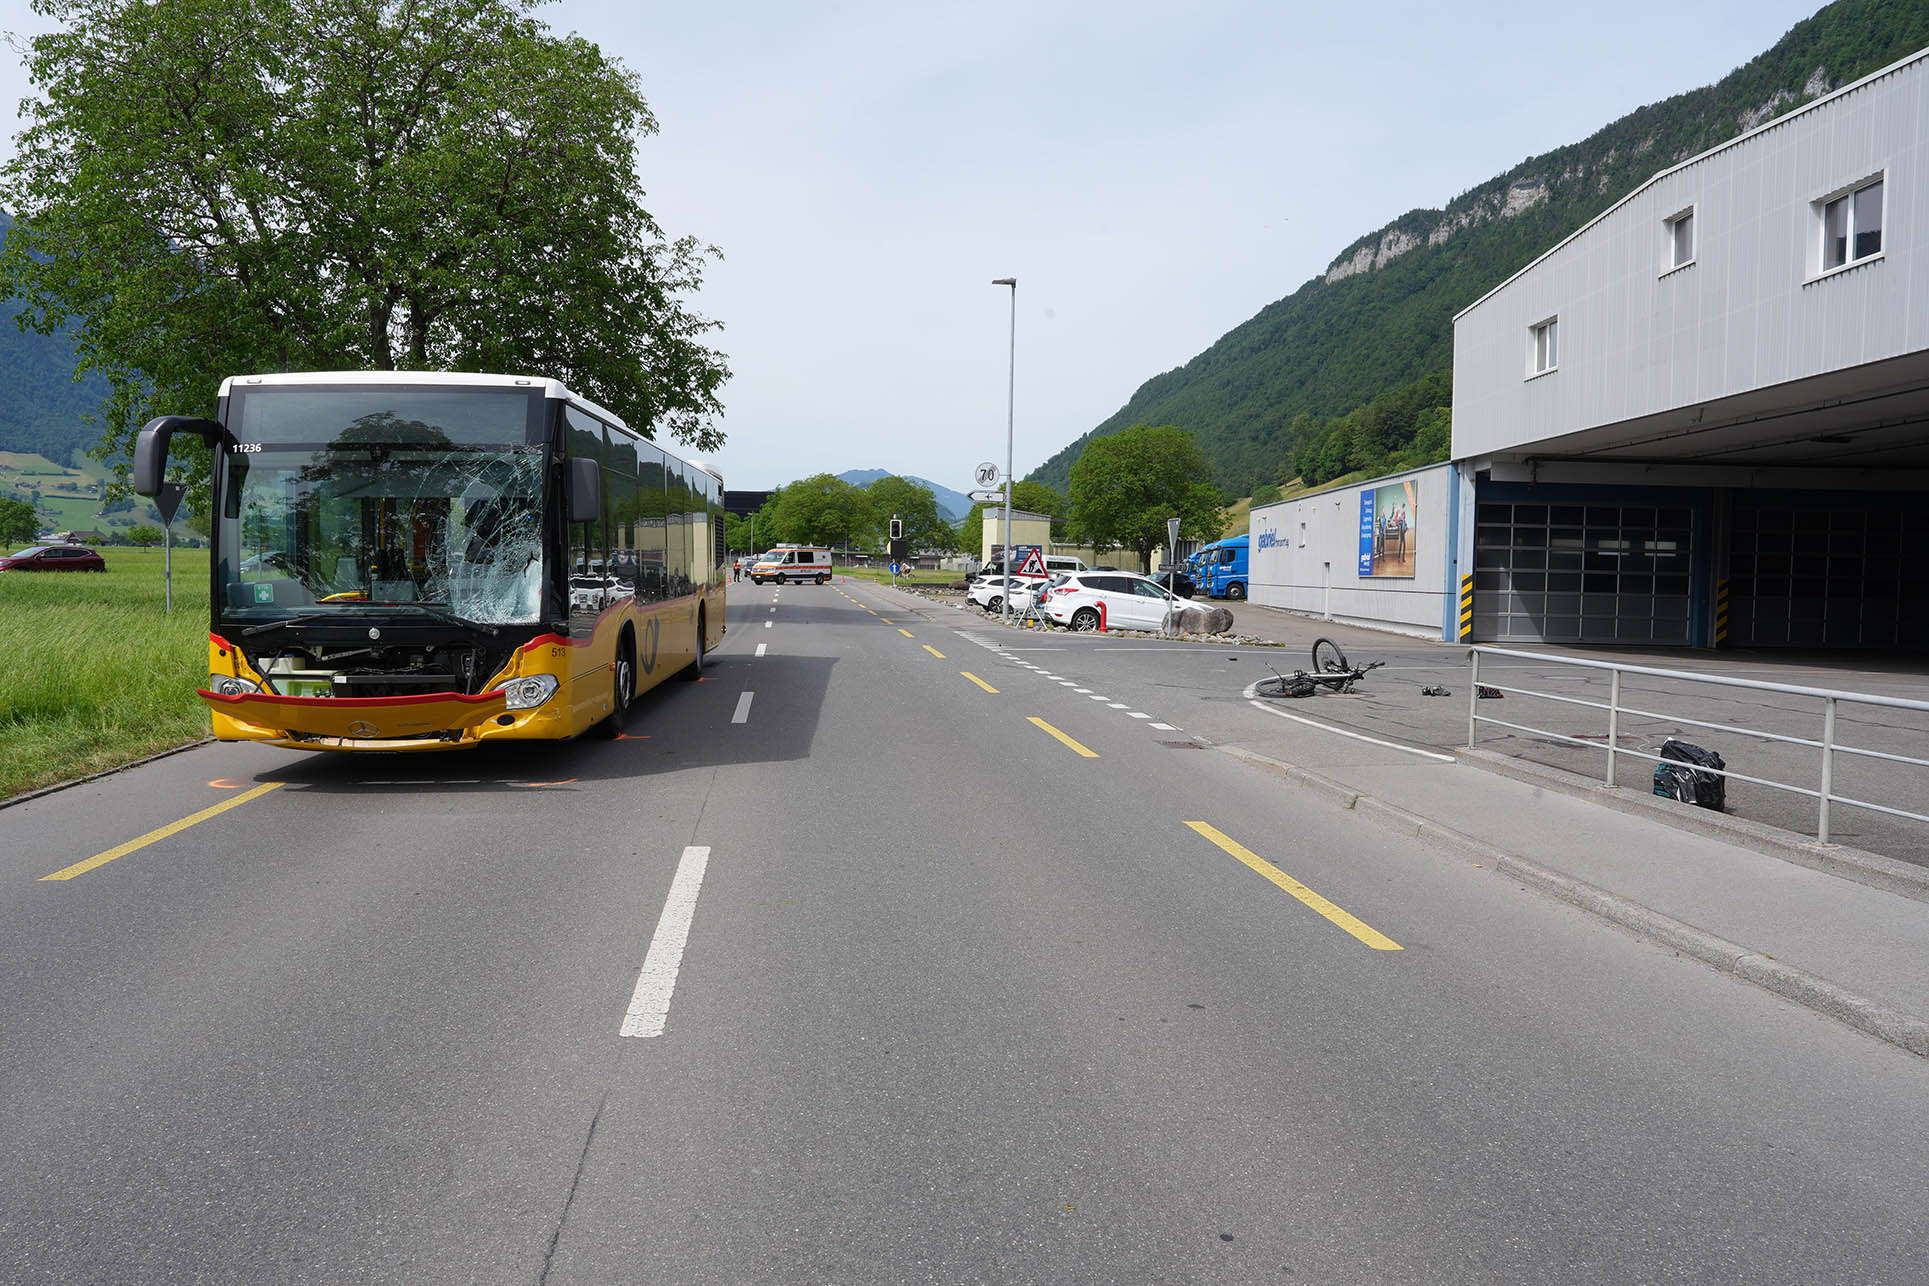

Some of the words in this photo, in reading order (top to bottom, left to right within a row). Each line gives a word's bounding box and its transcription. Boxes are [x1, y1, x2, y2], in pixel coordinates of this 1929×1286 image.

[232, 443, 262, 453] 11236
[980, 469, 995, 481] 70
[551, 647, 566, 657] 513
